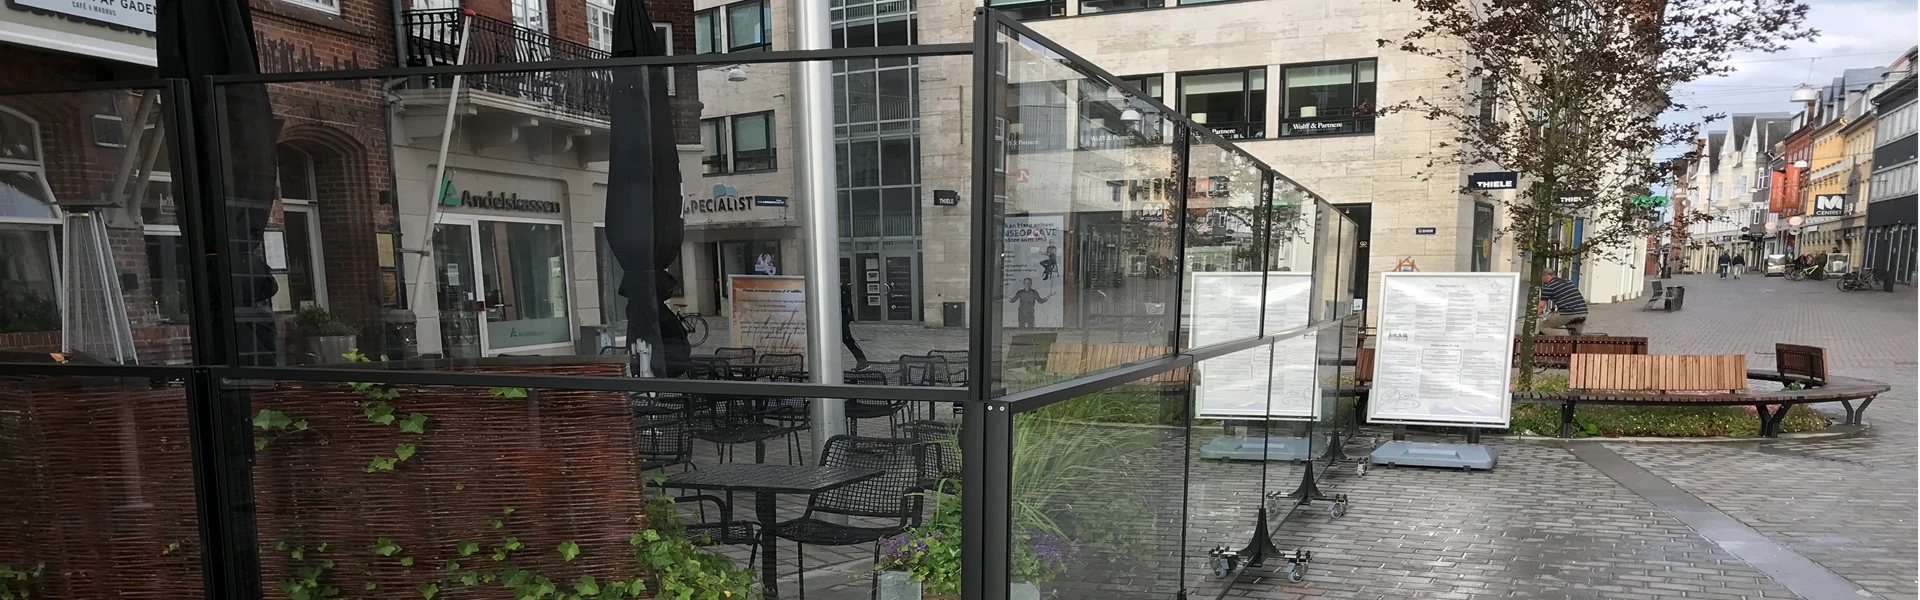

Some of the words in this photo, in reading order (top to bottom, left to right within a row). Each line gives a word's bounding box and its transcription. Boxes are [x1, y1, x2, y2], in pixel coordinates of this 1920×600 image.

[72, 1, 87, 10] CAFÉ
[94, 6, 116, 16] MADHUS
[1476, 180, 1513, 188] THIELE
[460, 189, 561, 214] Andelskassen
[1817, 194, 1843, 210] M
